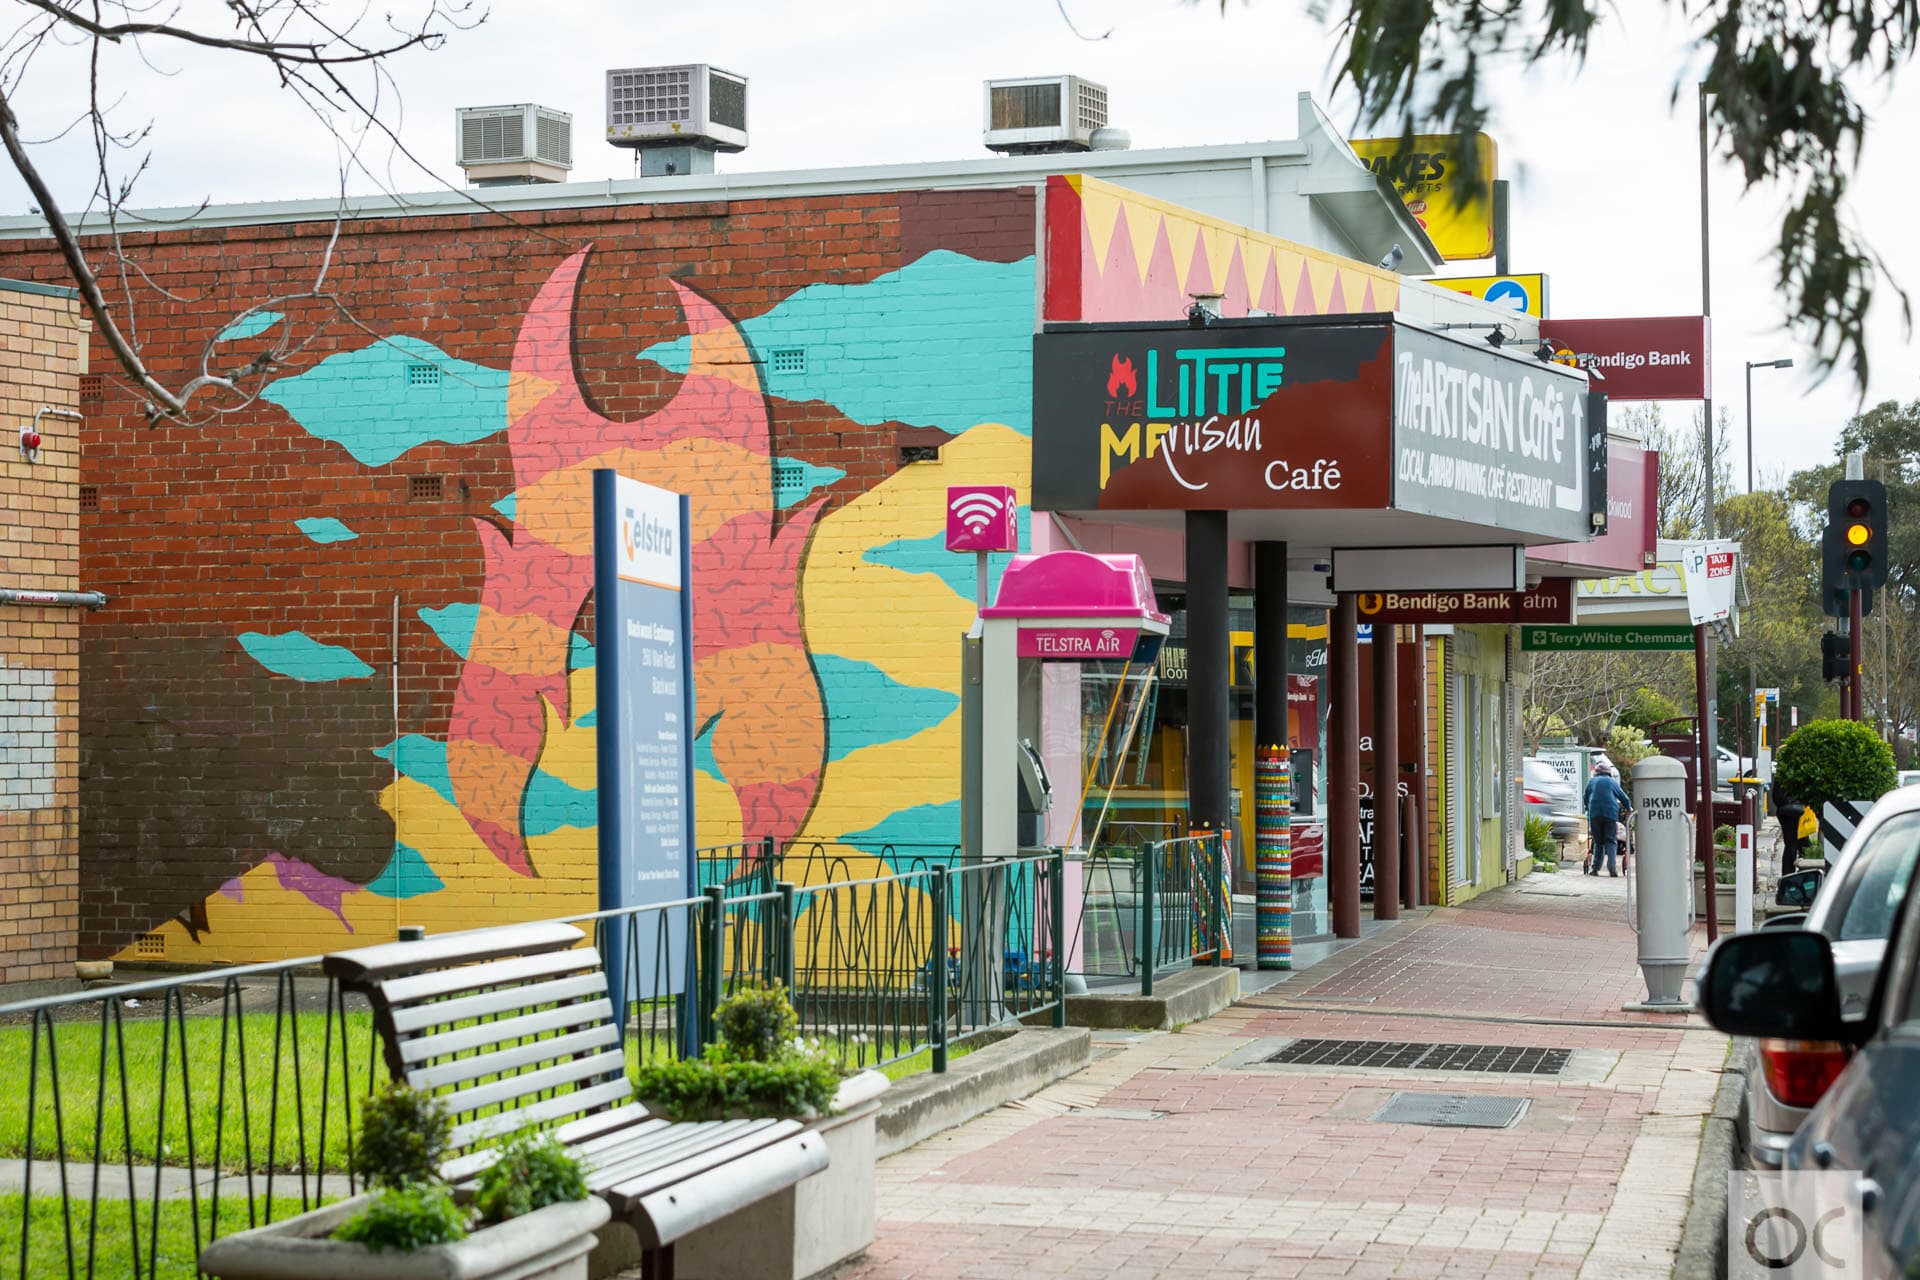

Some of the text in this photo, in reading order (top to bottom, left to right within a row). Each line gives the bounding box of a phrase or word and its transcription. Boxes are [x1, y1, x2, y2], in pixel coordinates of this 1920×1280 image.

[1649, 350, 1691, 366] Bank
[1104, 347, 1286, 418] THE LITTLE
[1420, 358, 1514, 453] ARTISAN
[1518, 375, 1565, 464] Café
[1264, 459, 1341, 490] Café
[1399, 447, 1428, 488] LOCAL,
[1427, 452, 1456, 489] AWARD
[1487, 463, 1506, 499] CAFÉ
[1505, 470, 1553, 510] RESTAURANT
[1711, 555, 1727, 564] TAXI
[1710, 566, 1731, 577] ZONE
[1386, 593, 1558, 613] Bendigo Bank atm
[1036, 637, 1091, 652] TELSTRA
[1550, 631, 1695, 646] TerryWhite Chemmart
[1554, 767, 1577, 775] KING
[1642, 797, 1680, 808] BKWD
[1648, 809, 1672, 821] P68
